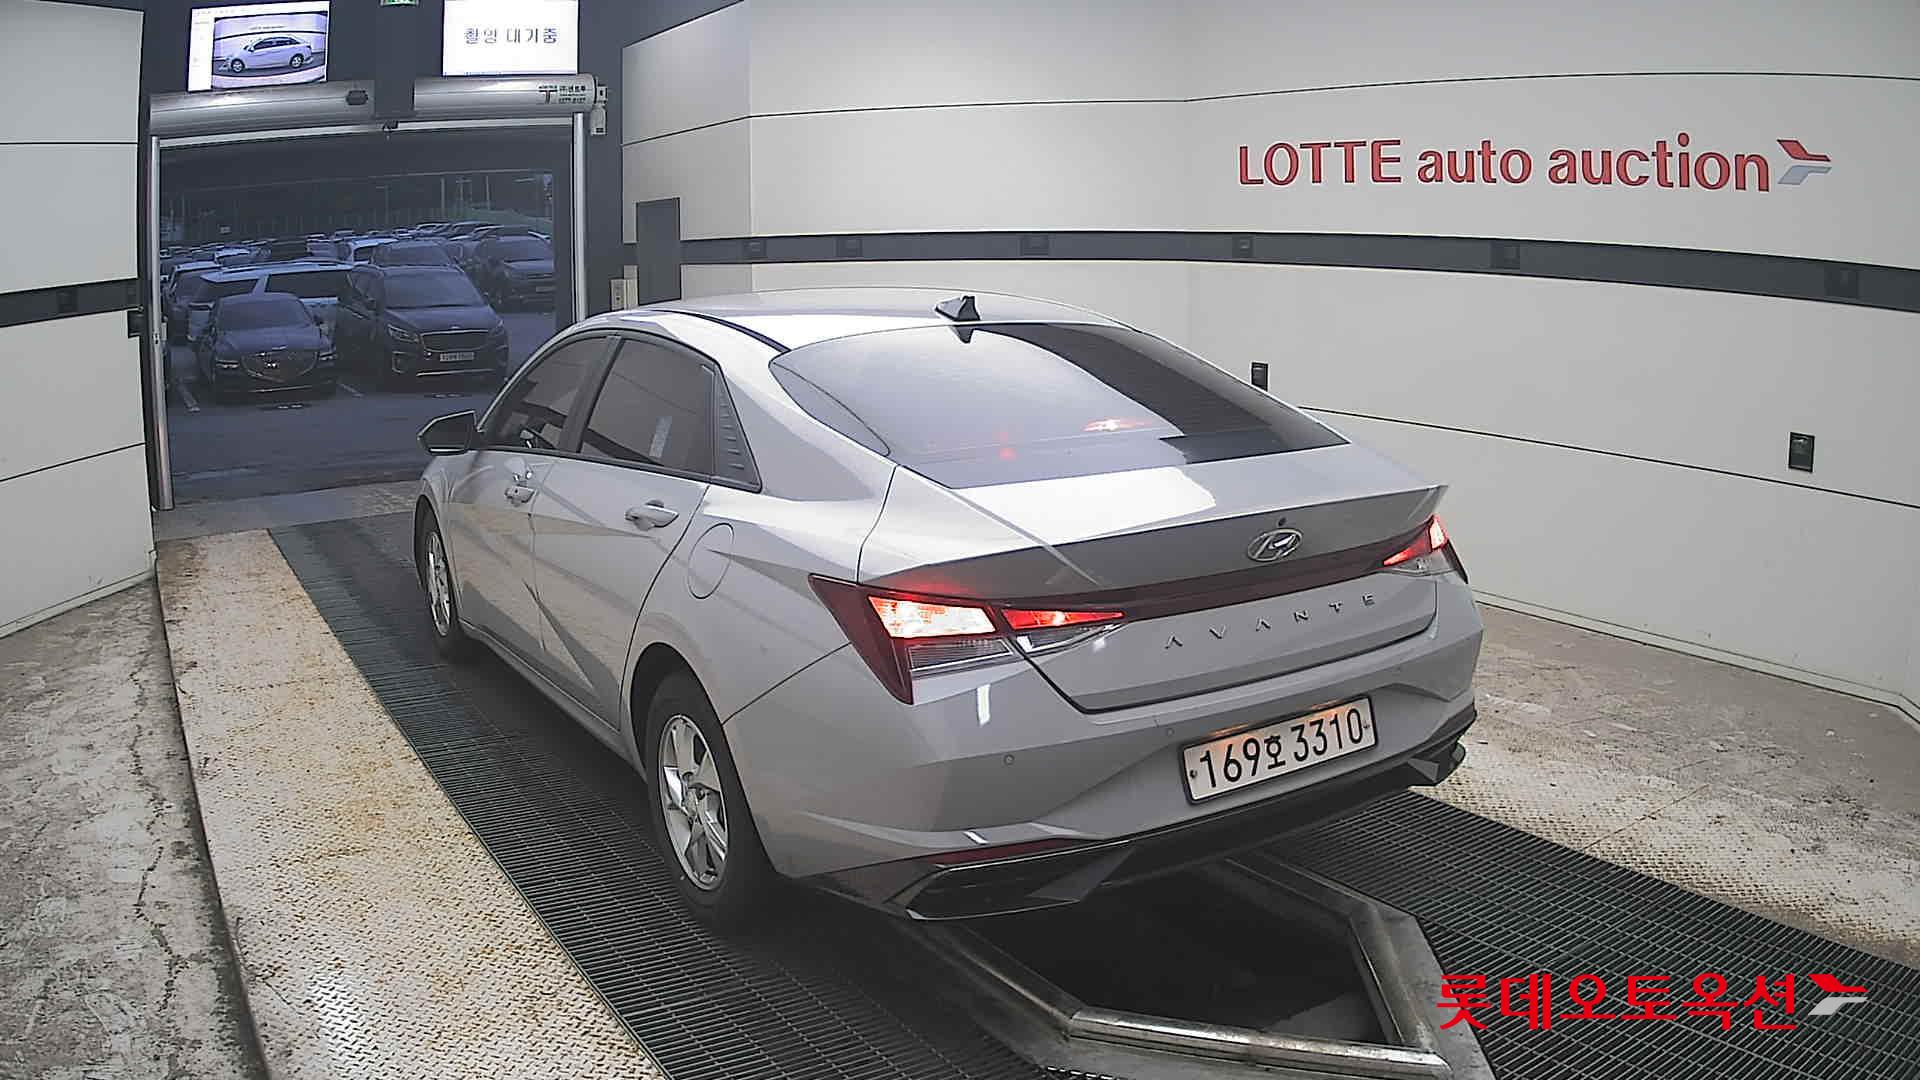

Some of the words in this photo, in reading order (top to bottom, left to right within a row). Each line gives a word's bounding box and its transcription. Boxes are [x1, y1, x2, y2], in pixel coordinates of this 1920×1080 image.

[1239, 138, 1402, 186] LOTTE
[1417, 139, 1533, 184] auto
[1548, 131, 1770, 193] auction
[1164, 592, 1376, 650] AVANTE
[1199, 735, 1286, 788] 169호
[1290, 708, 1364, 762] 3310
